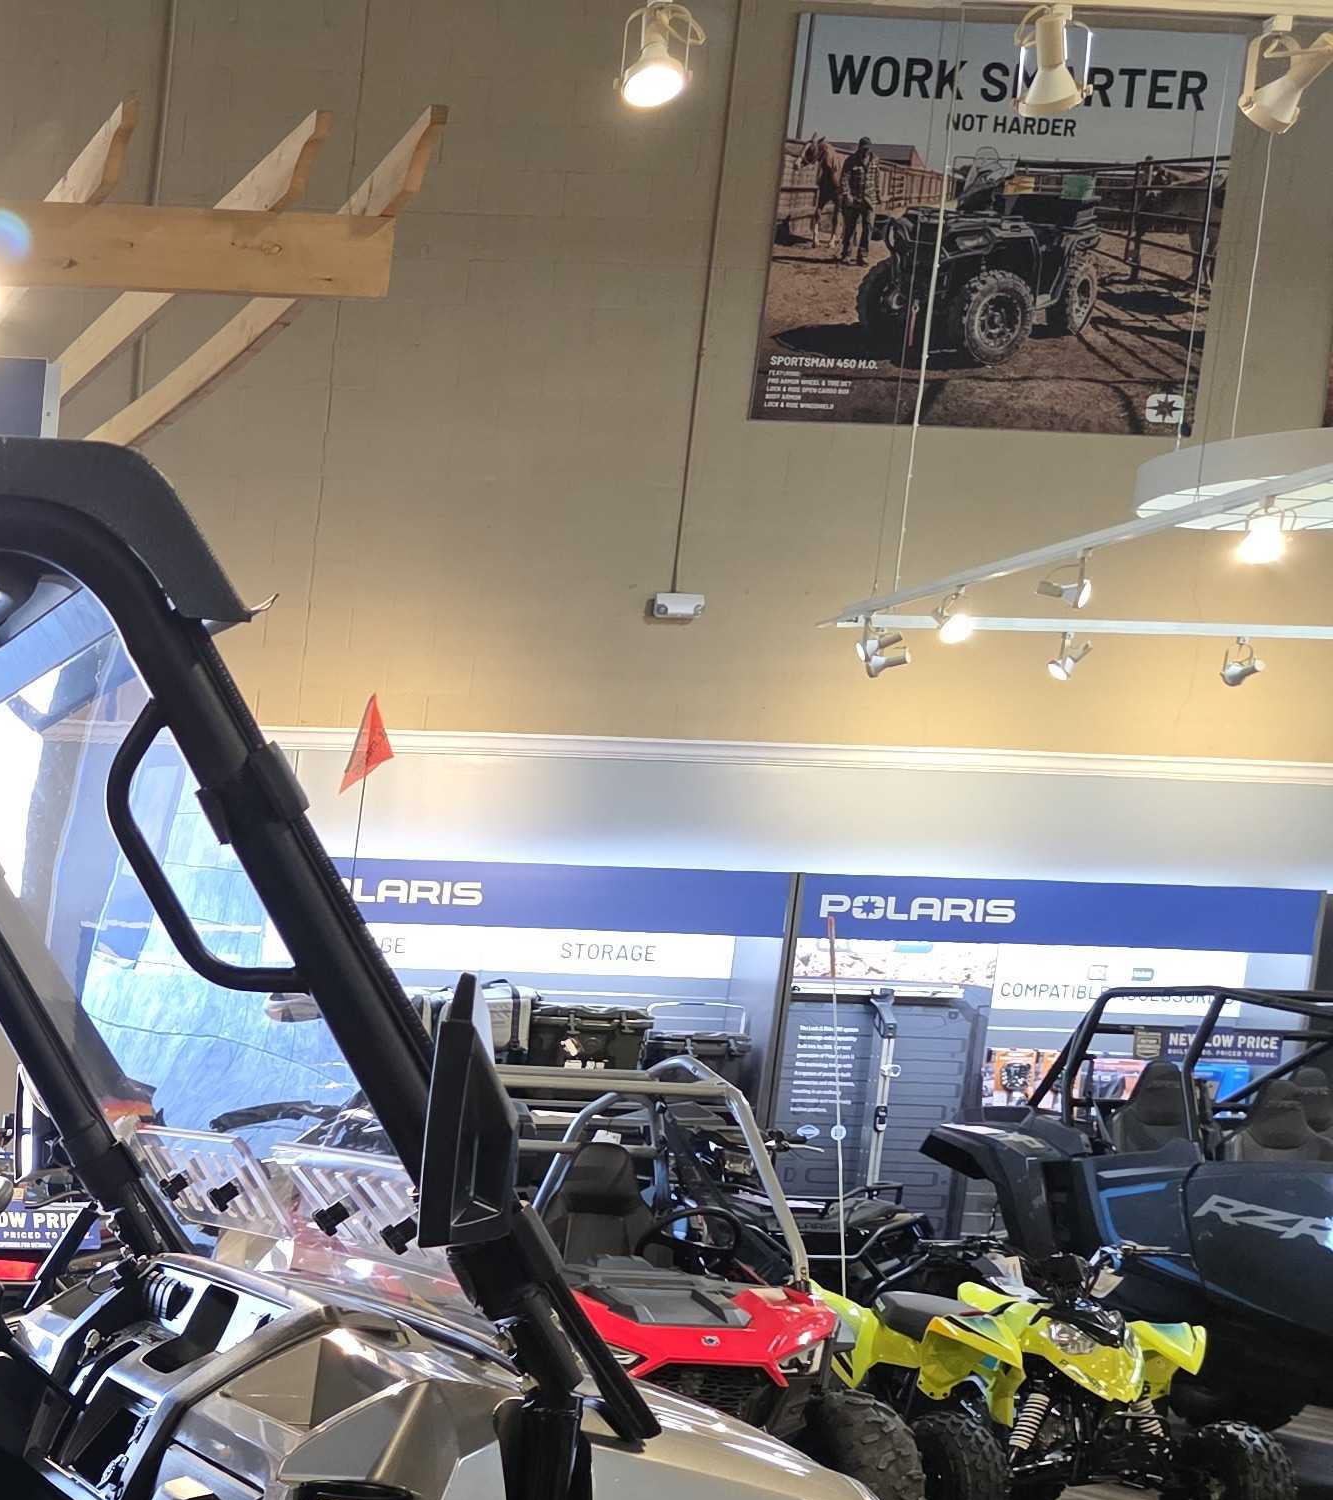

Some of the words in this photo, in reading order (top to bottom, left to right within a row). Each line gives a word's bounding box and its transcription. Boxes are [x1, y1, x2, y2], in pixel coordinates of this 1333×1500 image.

[828, 53, 968, 101] WORK
[947, 113, 985, 133] NOT
[993, 114, 1077, 138] HARDER
[770, 355, 834, 369] SPORTSMAN
[836, 358, 857, 369] 450
[342, 877, 484, 906] LARIS
[819, 894, 1016, 924] POLARIS
[560, 942, 656, 962] STORAGE
[1237, 1036, 1280, 1050] PRICE
[33, 1212, 77, 1229] PRIC
[3, 1231, 41, 1239] PRICED
[45, 1231, 58, 1239] TO
